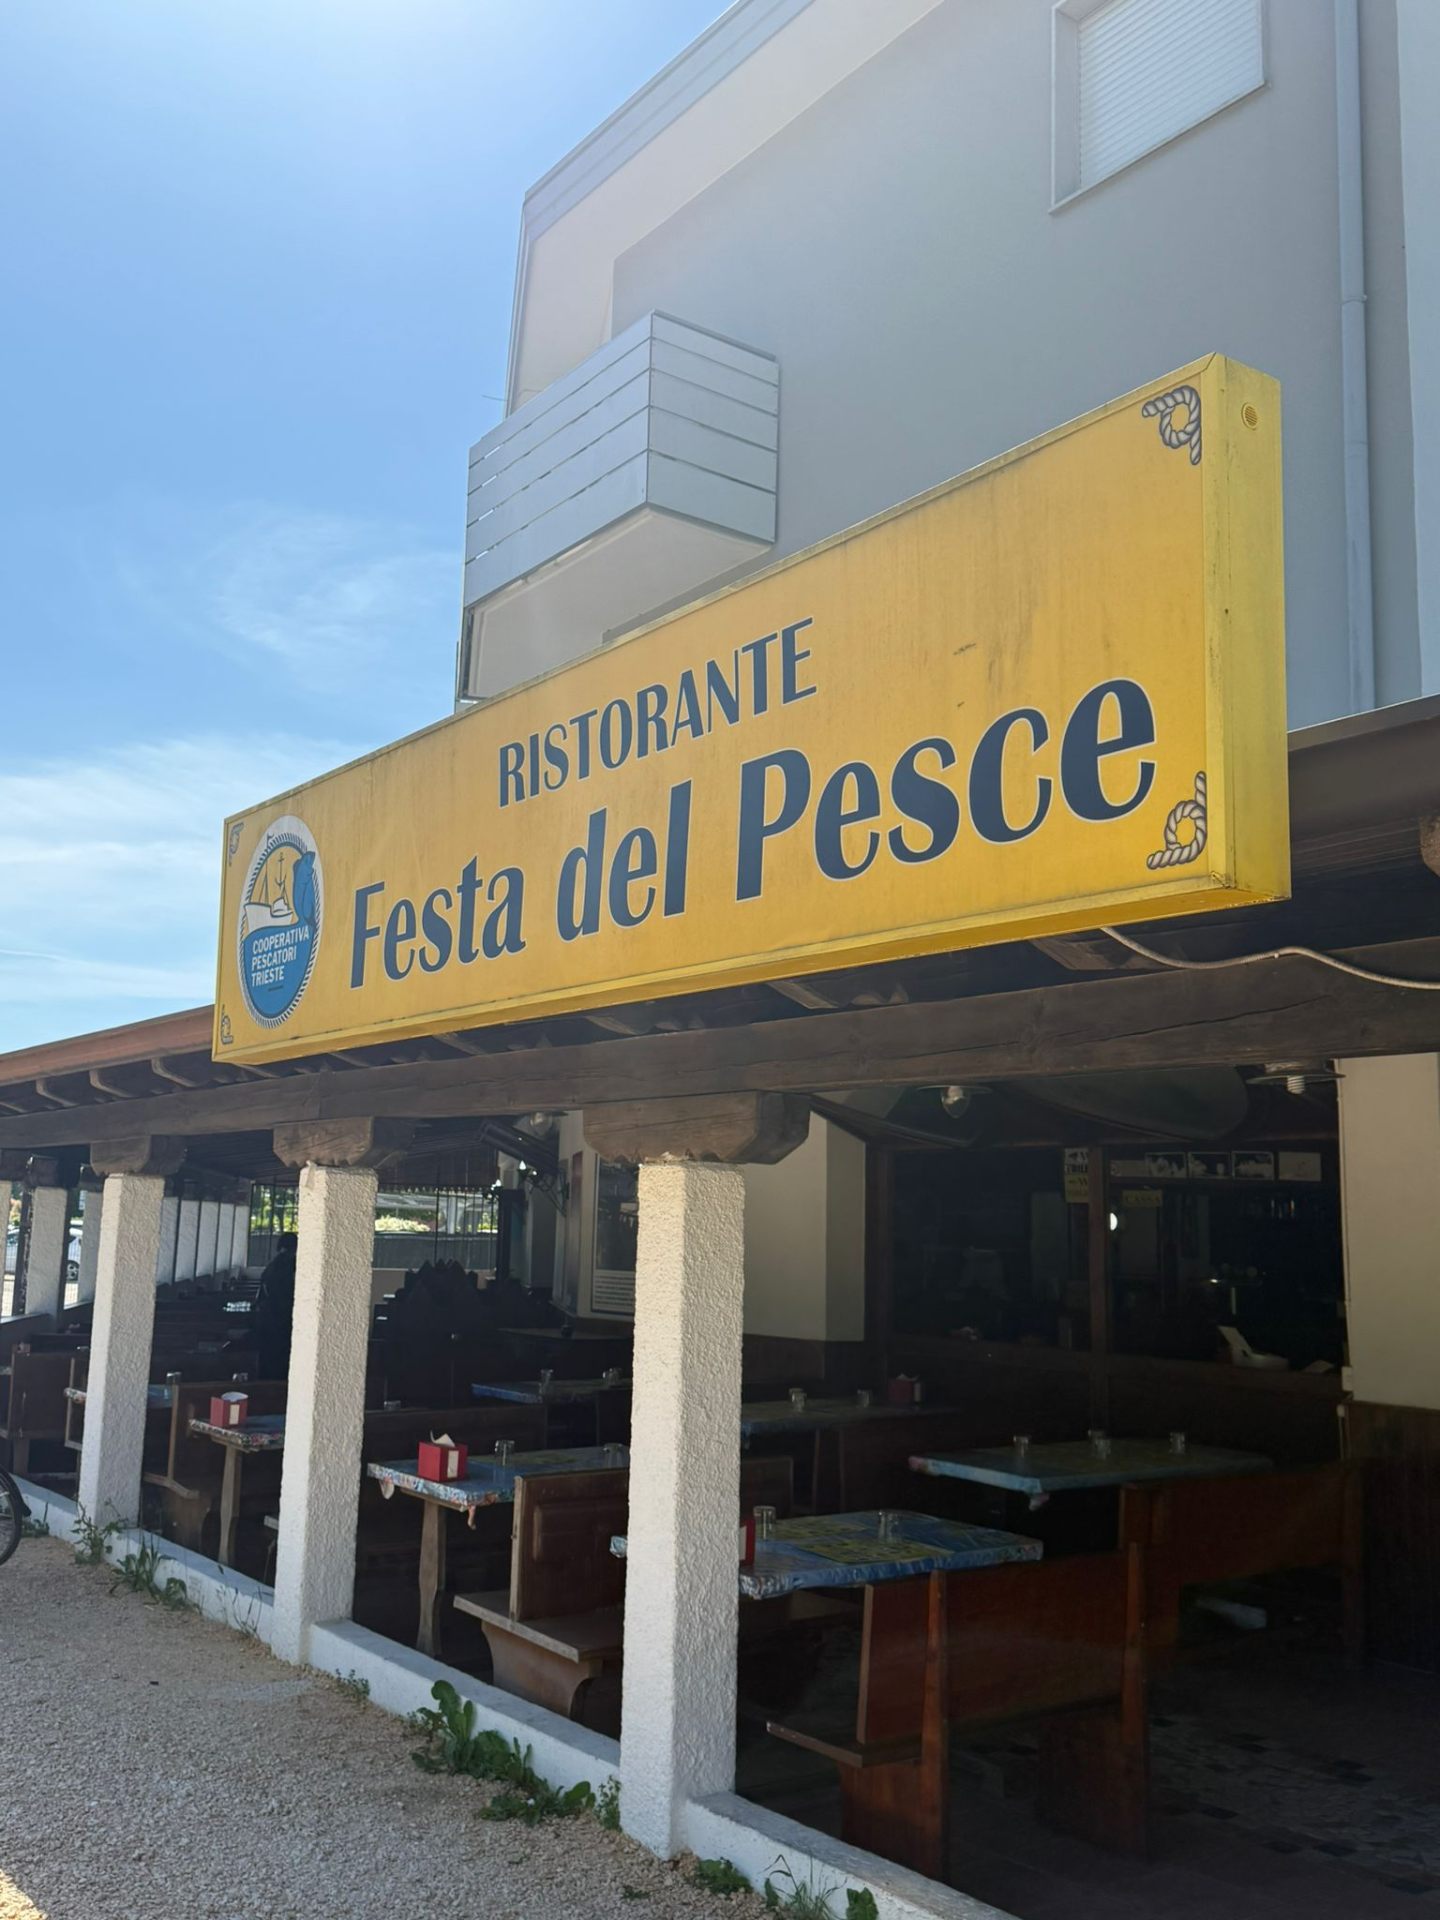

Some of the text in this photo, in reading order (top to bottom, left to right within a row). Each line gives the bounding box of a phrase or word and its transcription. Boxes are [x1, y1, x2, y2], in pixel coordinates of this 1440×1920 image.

[499, 616, 817, 808] RISTORANTE
[350, 677, 1157, 989] Festa del Pesce
[253, 925, 309, 955] COOPERATIVA
[252, 945, 297, 971] PESCATORI
[251, 965, 285, 987] TRIESTE
